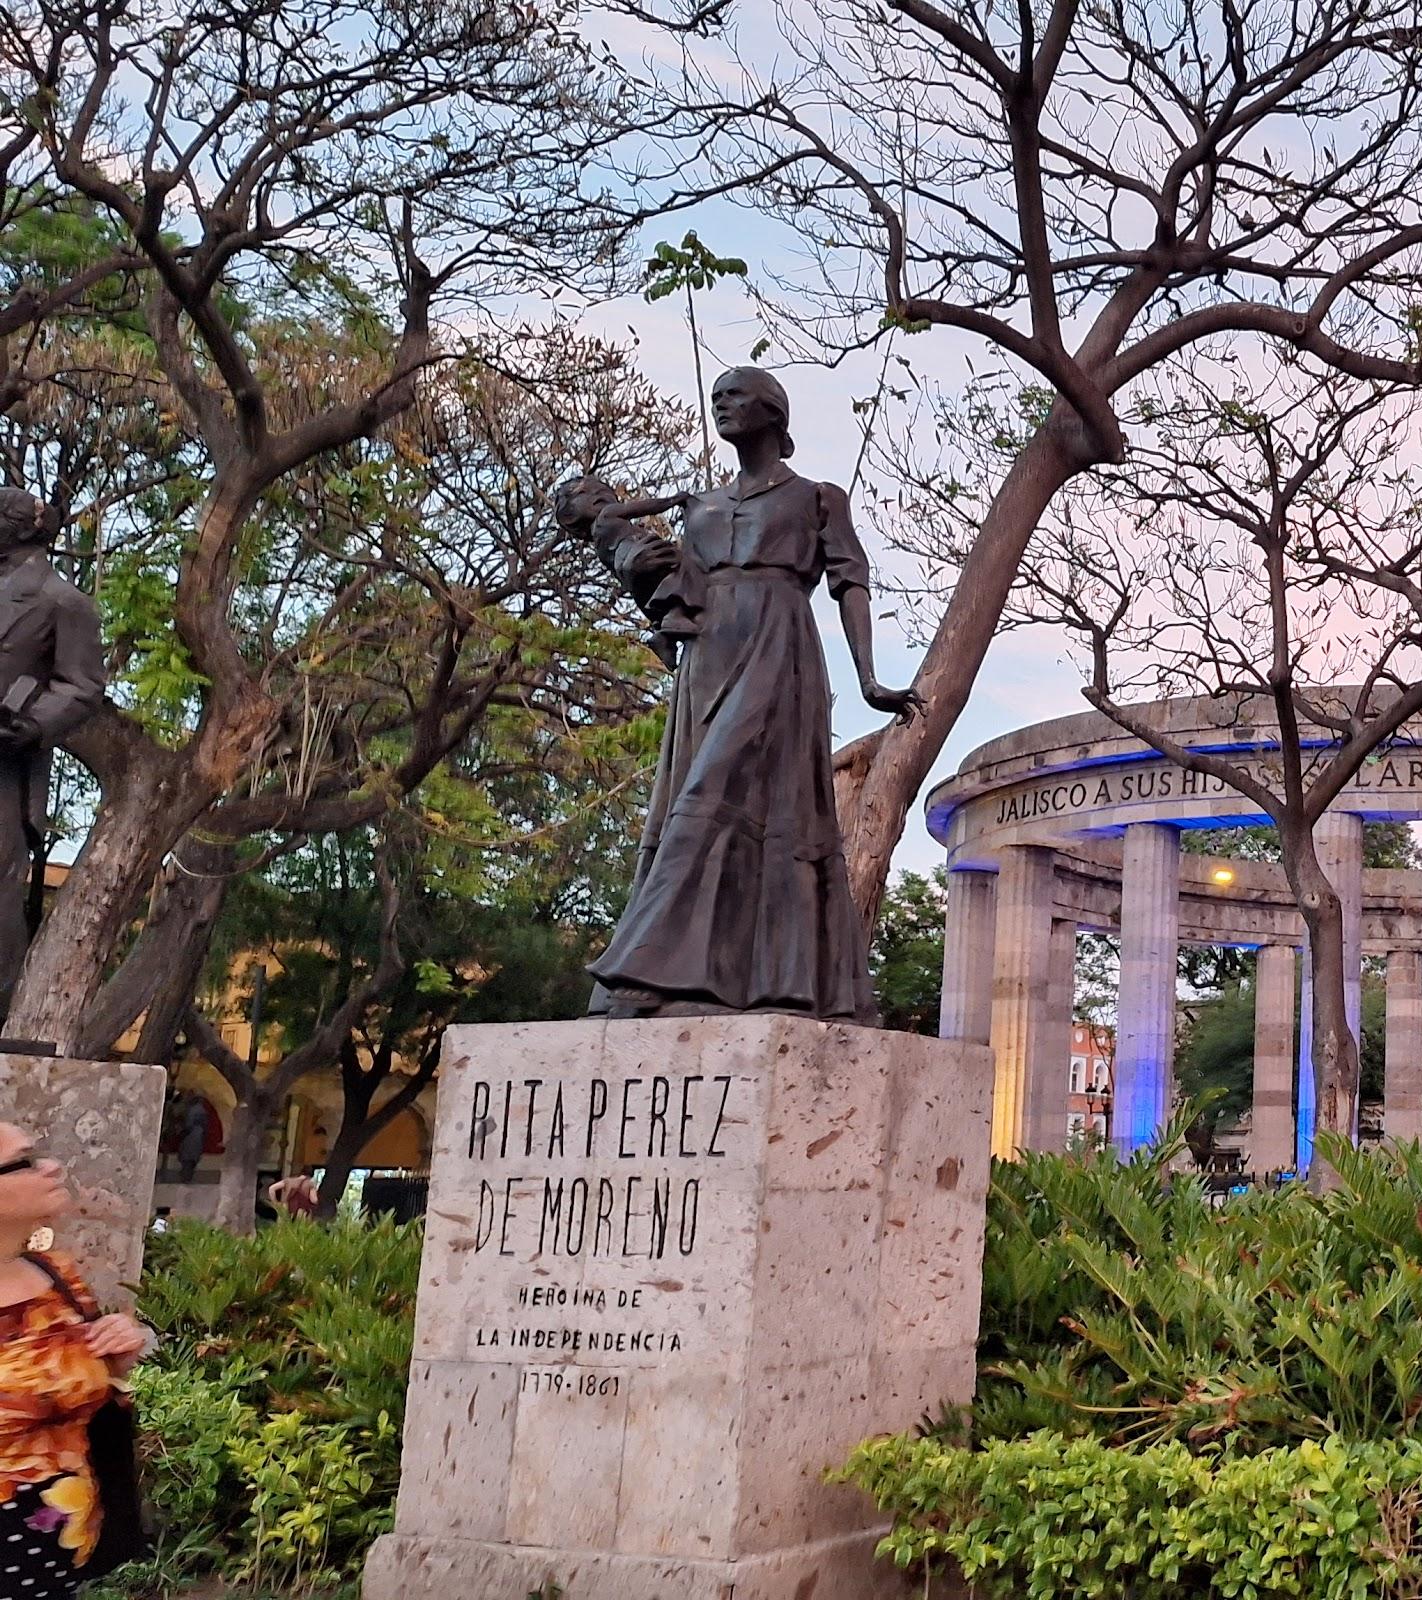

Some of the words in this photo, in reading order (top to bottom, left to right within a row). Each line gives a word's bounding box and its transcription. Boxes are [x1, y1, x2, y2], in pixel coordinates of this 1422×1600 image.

[997, 783, 1086, 824] JALISCO
[1093, 778, 1112, 805] A
[1120, 771, 1172, 801] SUS
[468, 1079, 565, 1160] RITA
[474, 1177, 523, 1256] DE
[538, 1176, 701, 1260] MORENO
[617, 1288, 643, 1308] DE
[476, 1327, 500, 1348] LA
[510, 1328, 682, 1352] INDEPENDENCIA
